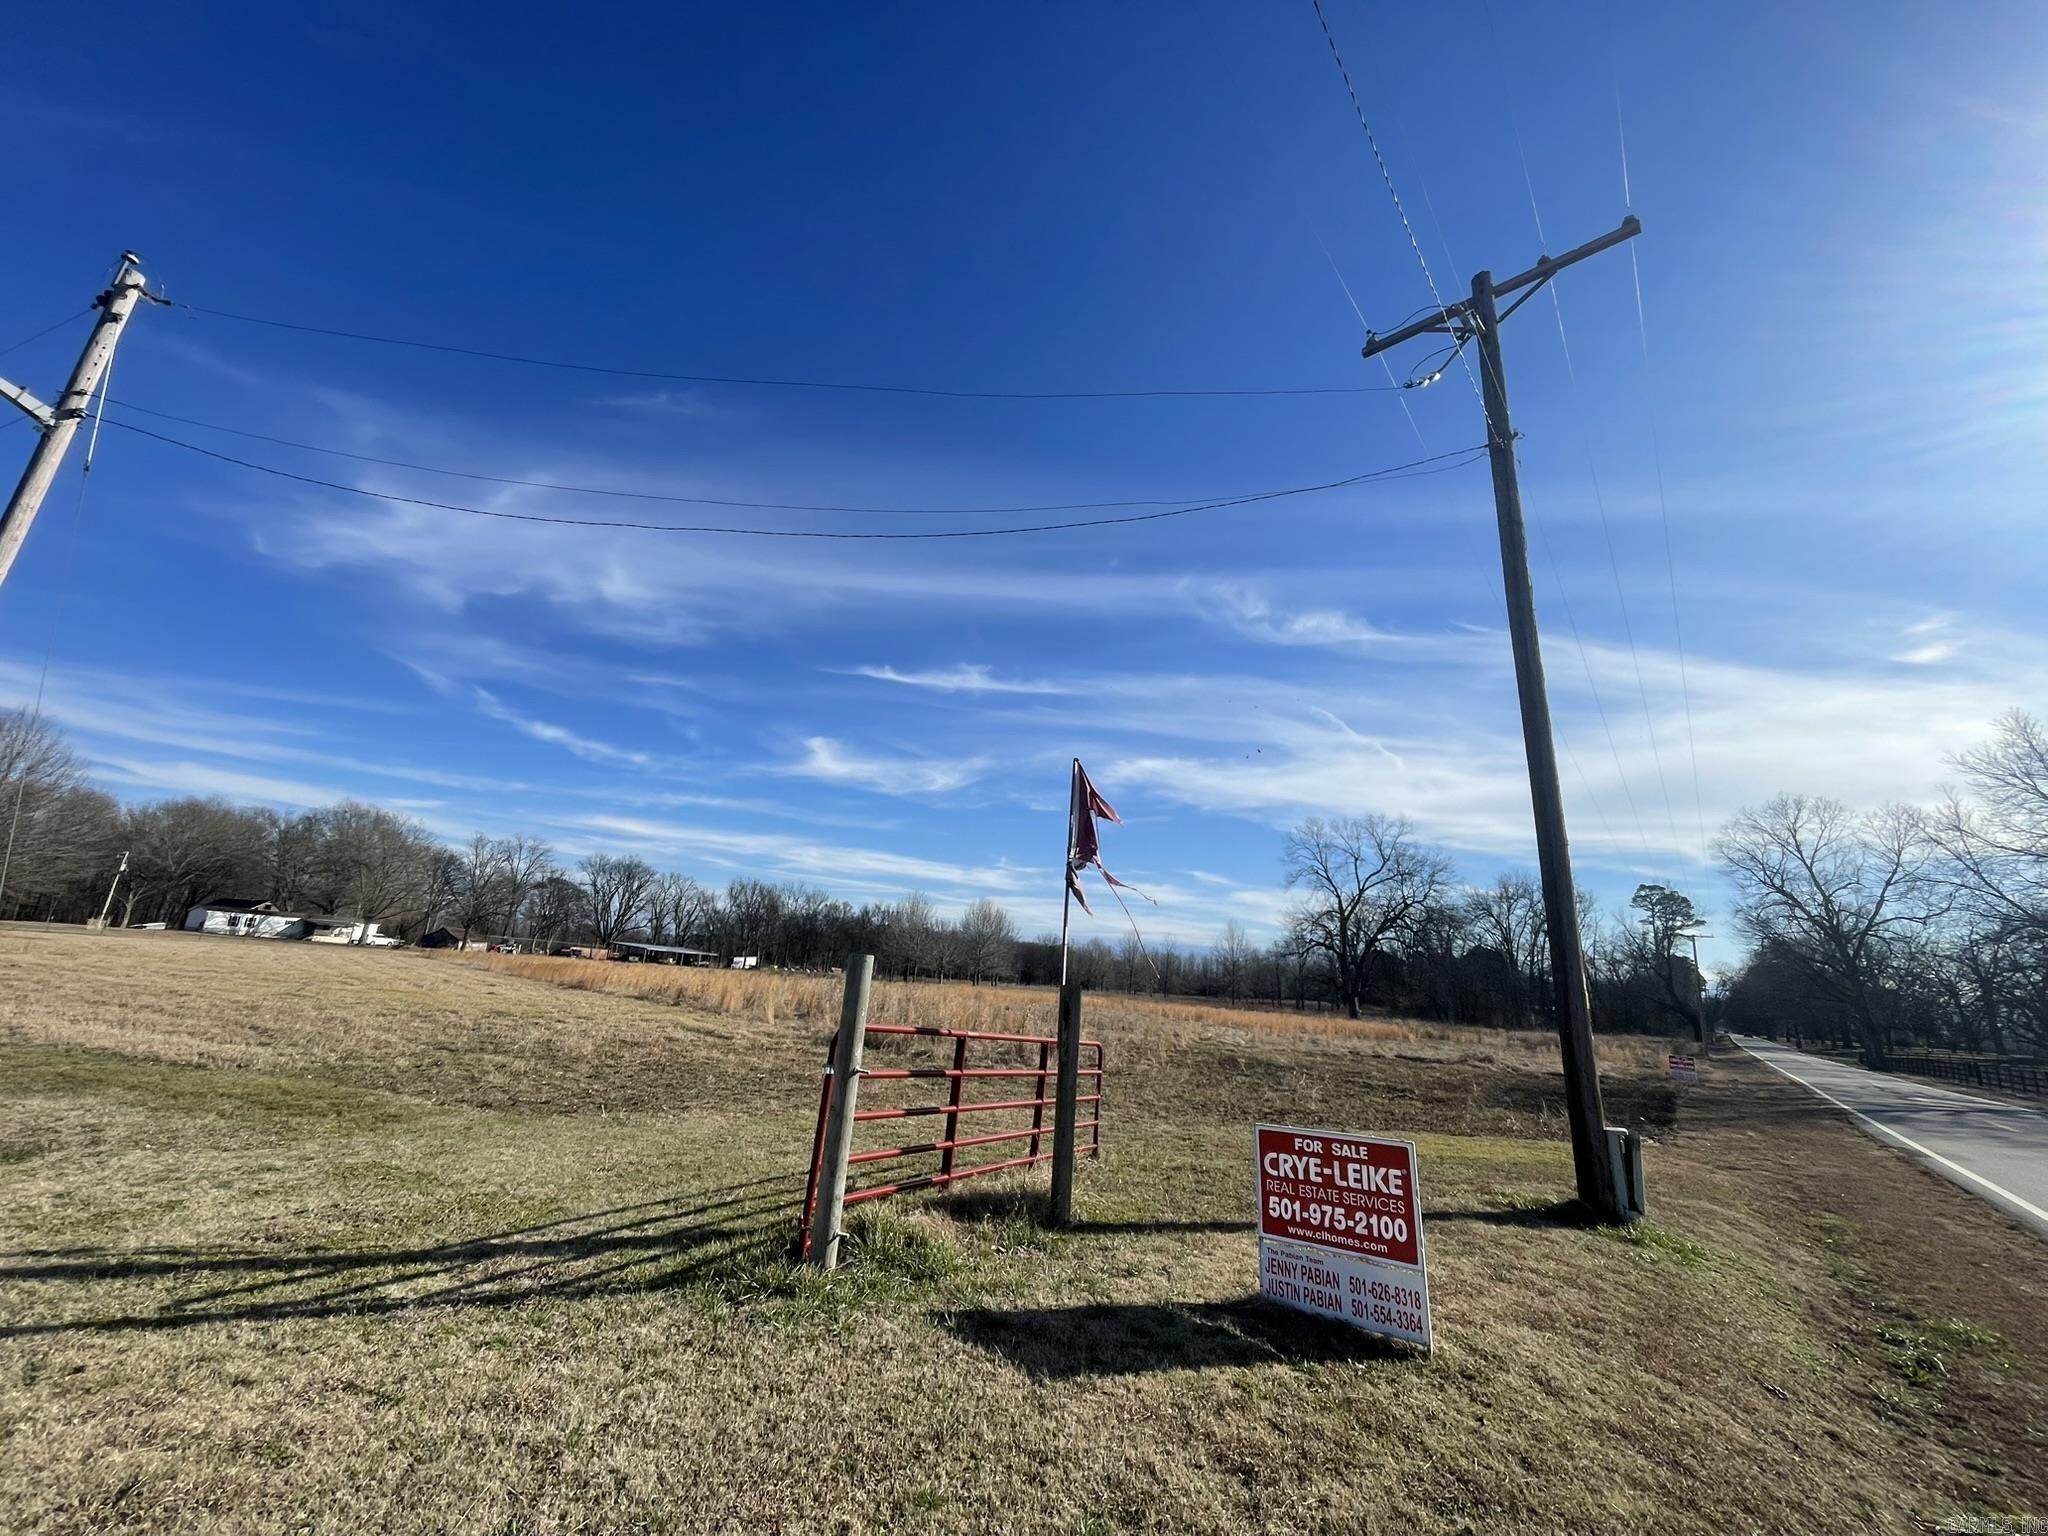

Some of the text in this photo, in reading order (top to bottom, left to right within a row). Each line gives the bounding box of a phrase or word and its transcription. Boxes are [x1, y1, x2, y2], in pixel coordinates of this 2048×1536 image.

[1295, 1138, 1368, 1159] FOR SALE
[1267, 1180, 1404, 1214] REAL ESTATE SERVICES
[1269, 1196, 1407, 1242] 501-975-2100
[1267, 1247, 1323, 1265] The Pabian Team
[1288, 1225, 1387, 1253] www.clhomes.com
[1265, 1258, 1420, 1309] JENNY PABIAN 501-626-8318
[1266, 1279, 1423, 1334] JUSTIN PABIAN 501-554-3364
